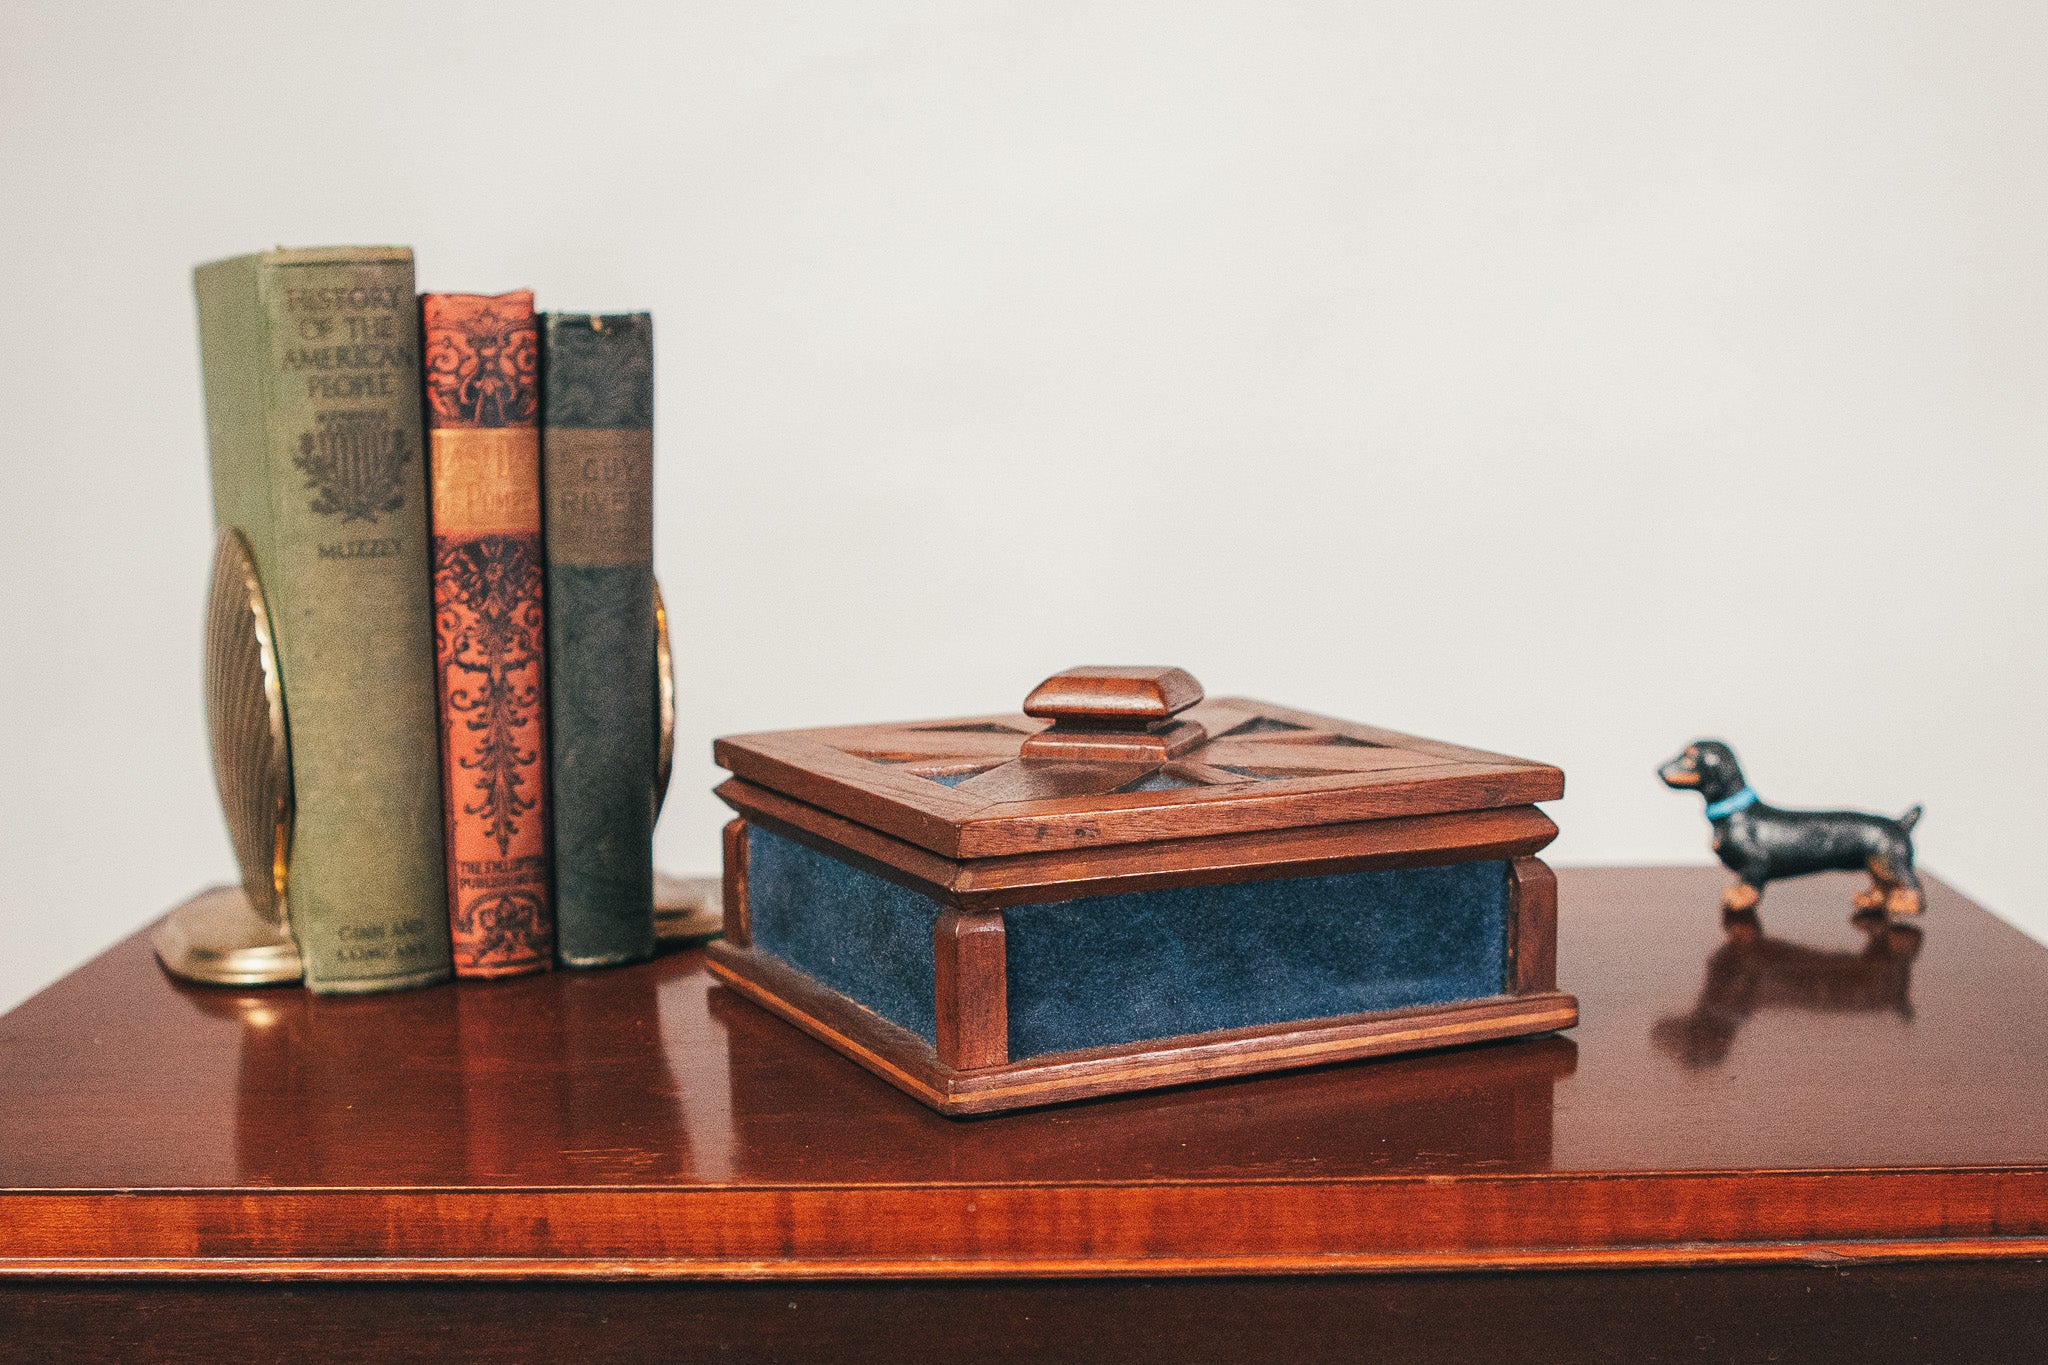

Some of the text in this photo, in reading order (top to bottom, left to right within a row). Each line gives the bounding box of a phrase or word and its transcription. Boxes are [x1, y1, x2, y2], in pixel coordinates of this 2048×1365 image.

[285, 285, 402, 312] HISTORY
[299, 315, 393, 340] OF THE
[281, 344, 414, 372] AMERICAN
[306, 373, 394, 399] PEOPLE
[316, 537, 402, 559] MUZZEY
